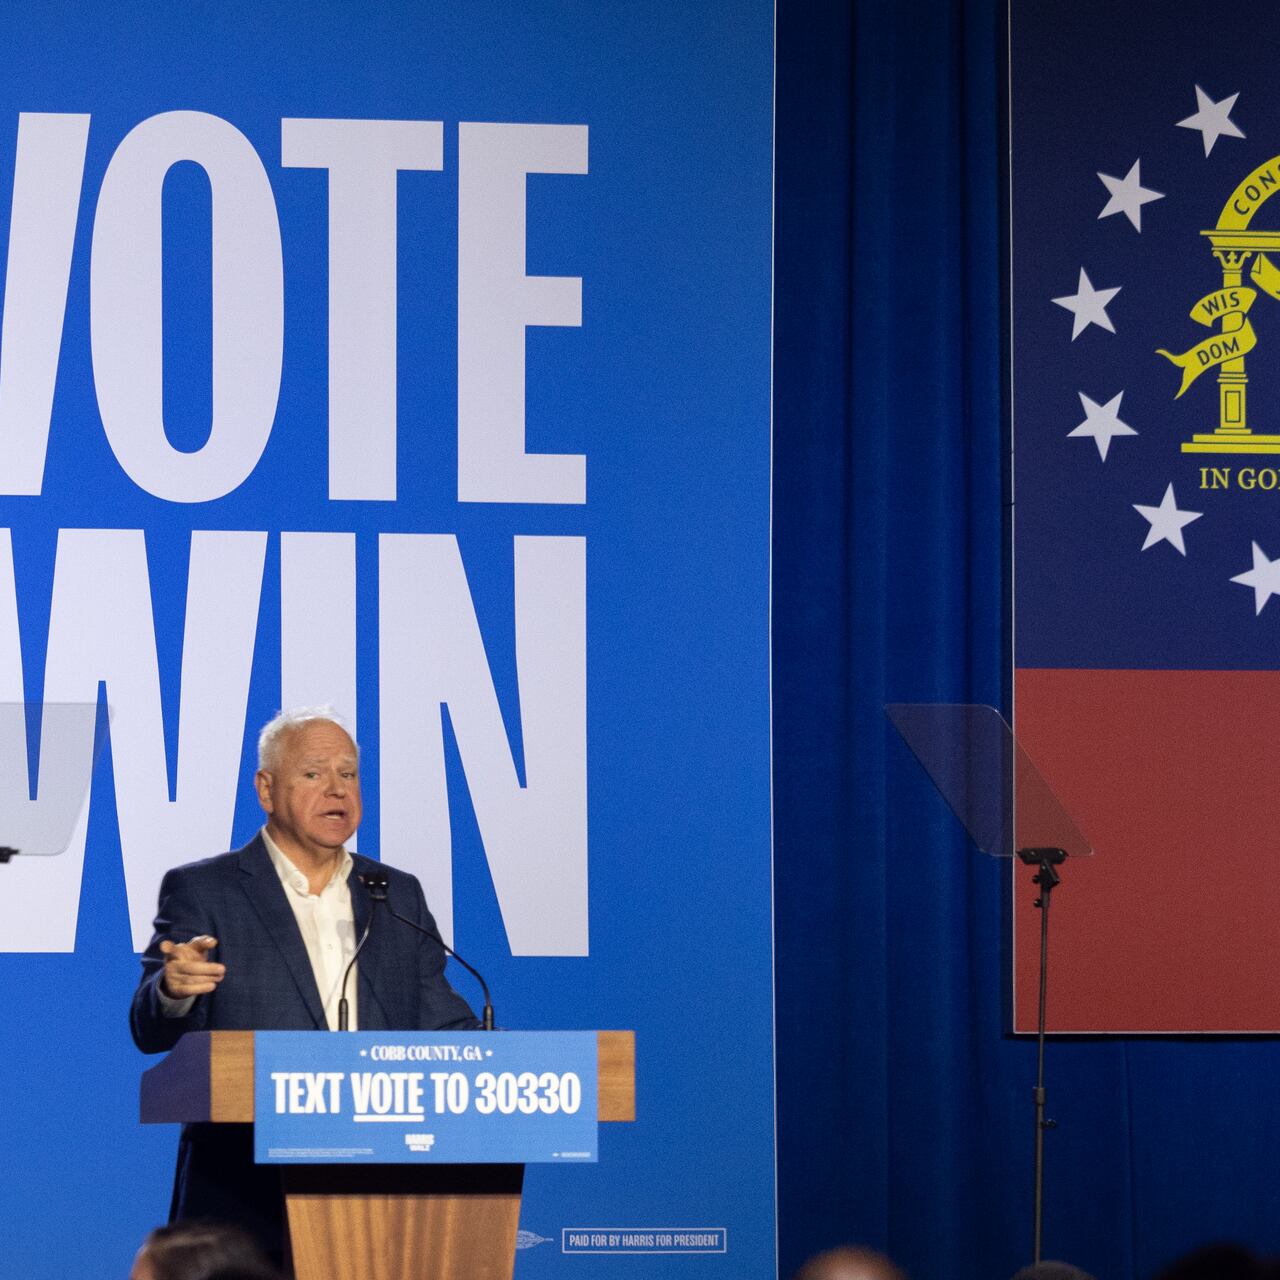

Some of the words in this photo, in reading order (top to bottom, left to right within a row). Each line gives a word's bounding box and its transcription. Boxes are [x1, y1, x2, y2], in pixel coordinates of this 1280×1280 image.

[1201, 291, 1240, 316] WIS
[1196, 337, 1240, 366] DOM
[1199, 467, 1231, 489] IN
[370, 1045, 407, 1061] COBB
[407, 1045, 462, 1063] COUNTY,
[463, 1045, 483, 1061] GA
[270, 1072, 345, 1114] TEXT
[350, 1071, 425, 1115] VOTE
[429, 1071, 470, 1115] TO
[474, 1071, 582, 1115] 30330
[569, 1234, 589, 1247] PAID
[591, 1234, 608, 1247] FOR
[609, 1234, 620, 1247] BY
[622, 1234, 654, 1247] HARRIS
[656, 1234, 673, 1247] FOR
[674, 1234, 719, 1247] PRESIDENT
